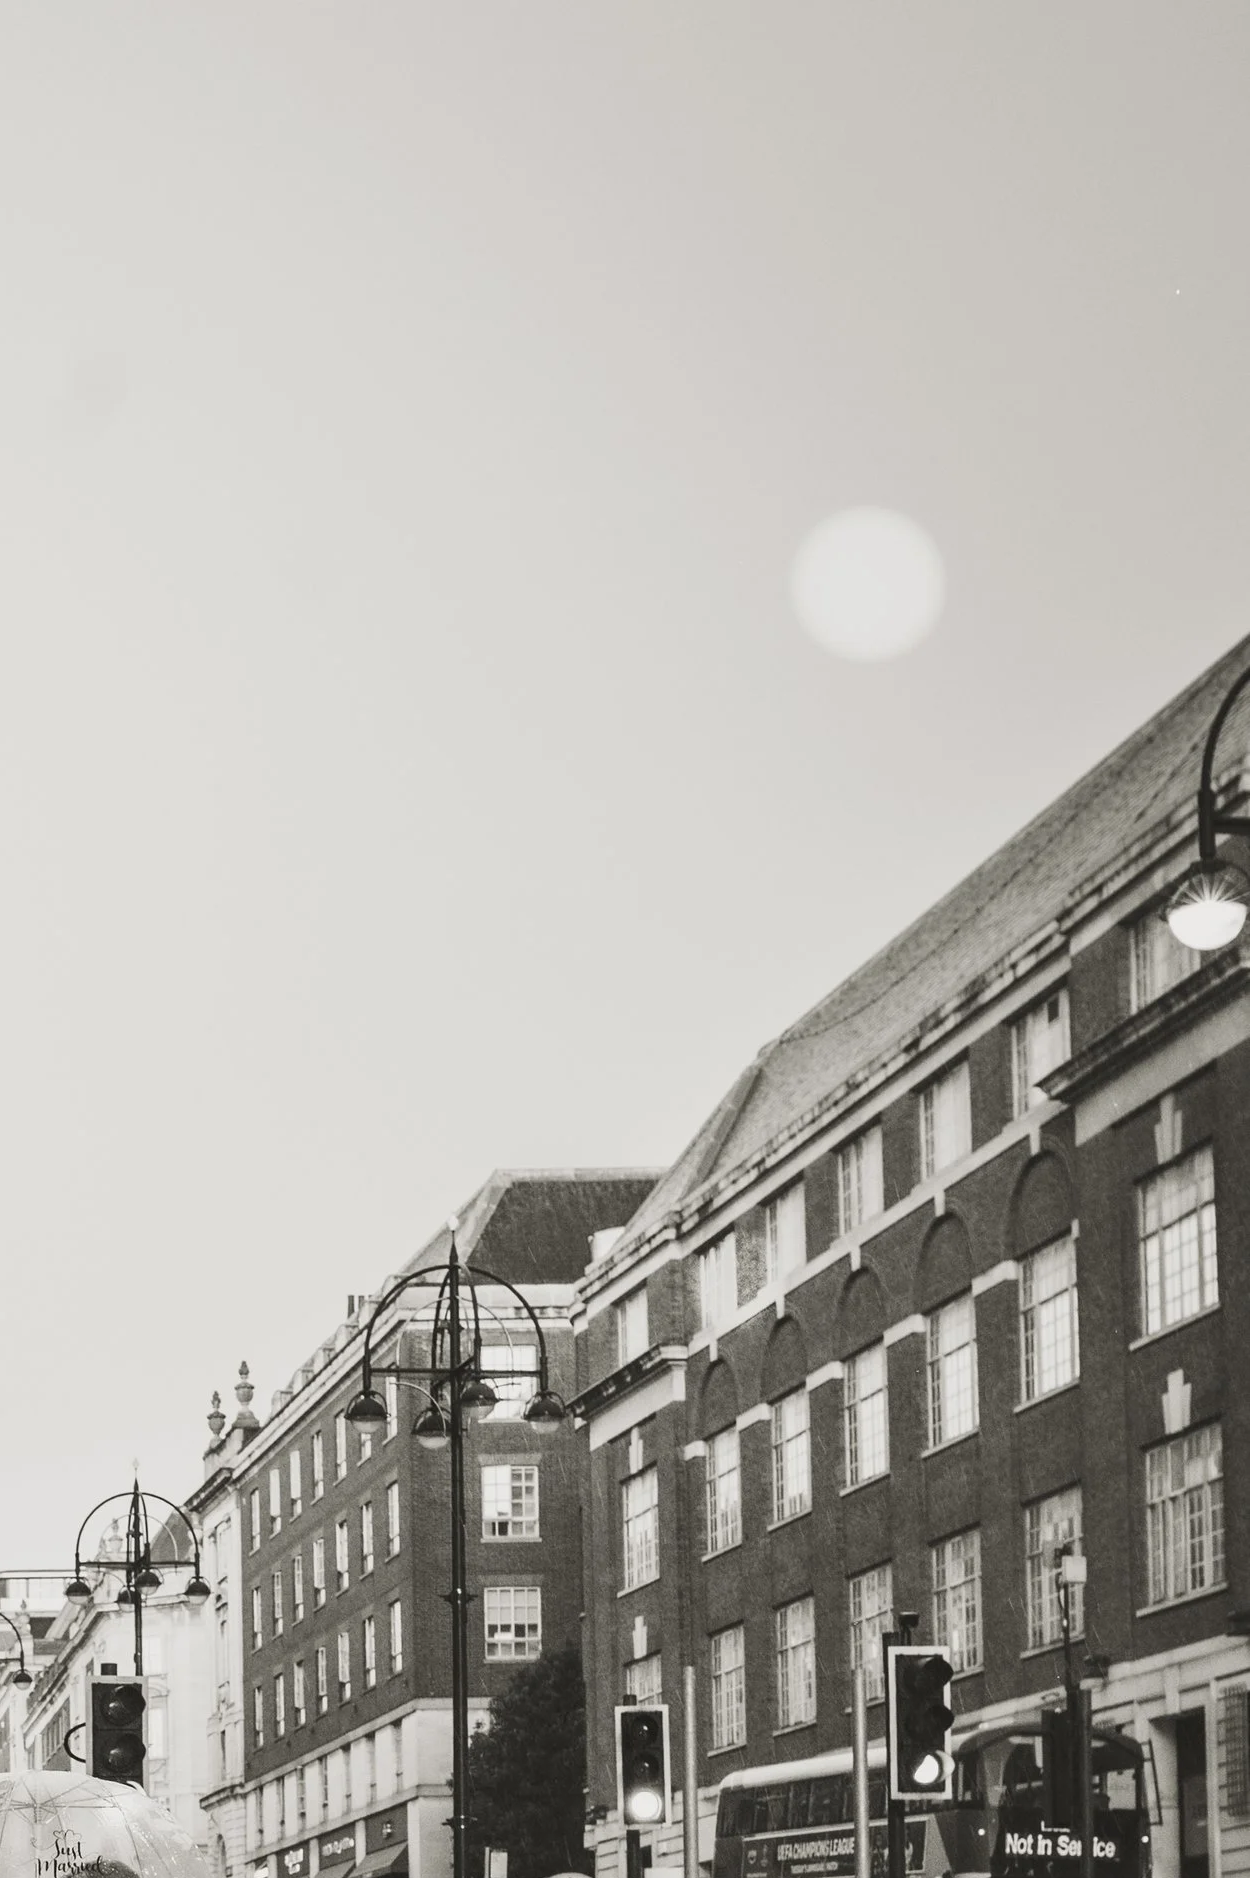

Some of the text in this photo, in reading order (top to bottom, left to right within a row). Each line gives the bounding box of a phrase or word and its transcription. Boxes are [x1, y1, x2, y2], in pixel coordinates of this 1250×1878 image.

[53, 1838, 85, 1860] Just
[793, 1840, 830, 1859] CHAMPIONS
[829, 1836, 855, 1857] LEAGUE
[1005, 1832, 1116, 1858] Not in Serice
